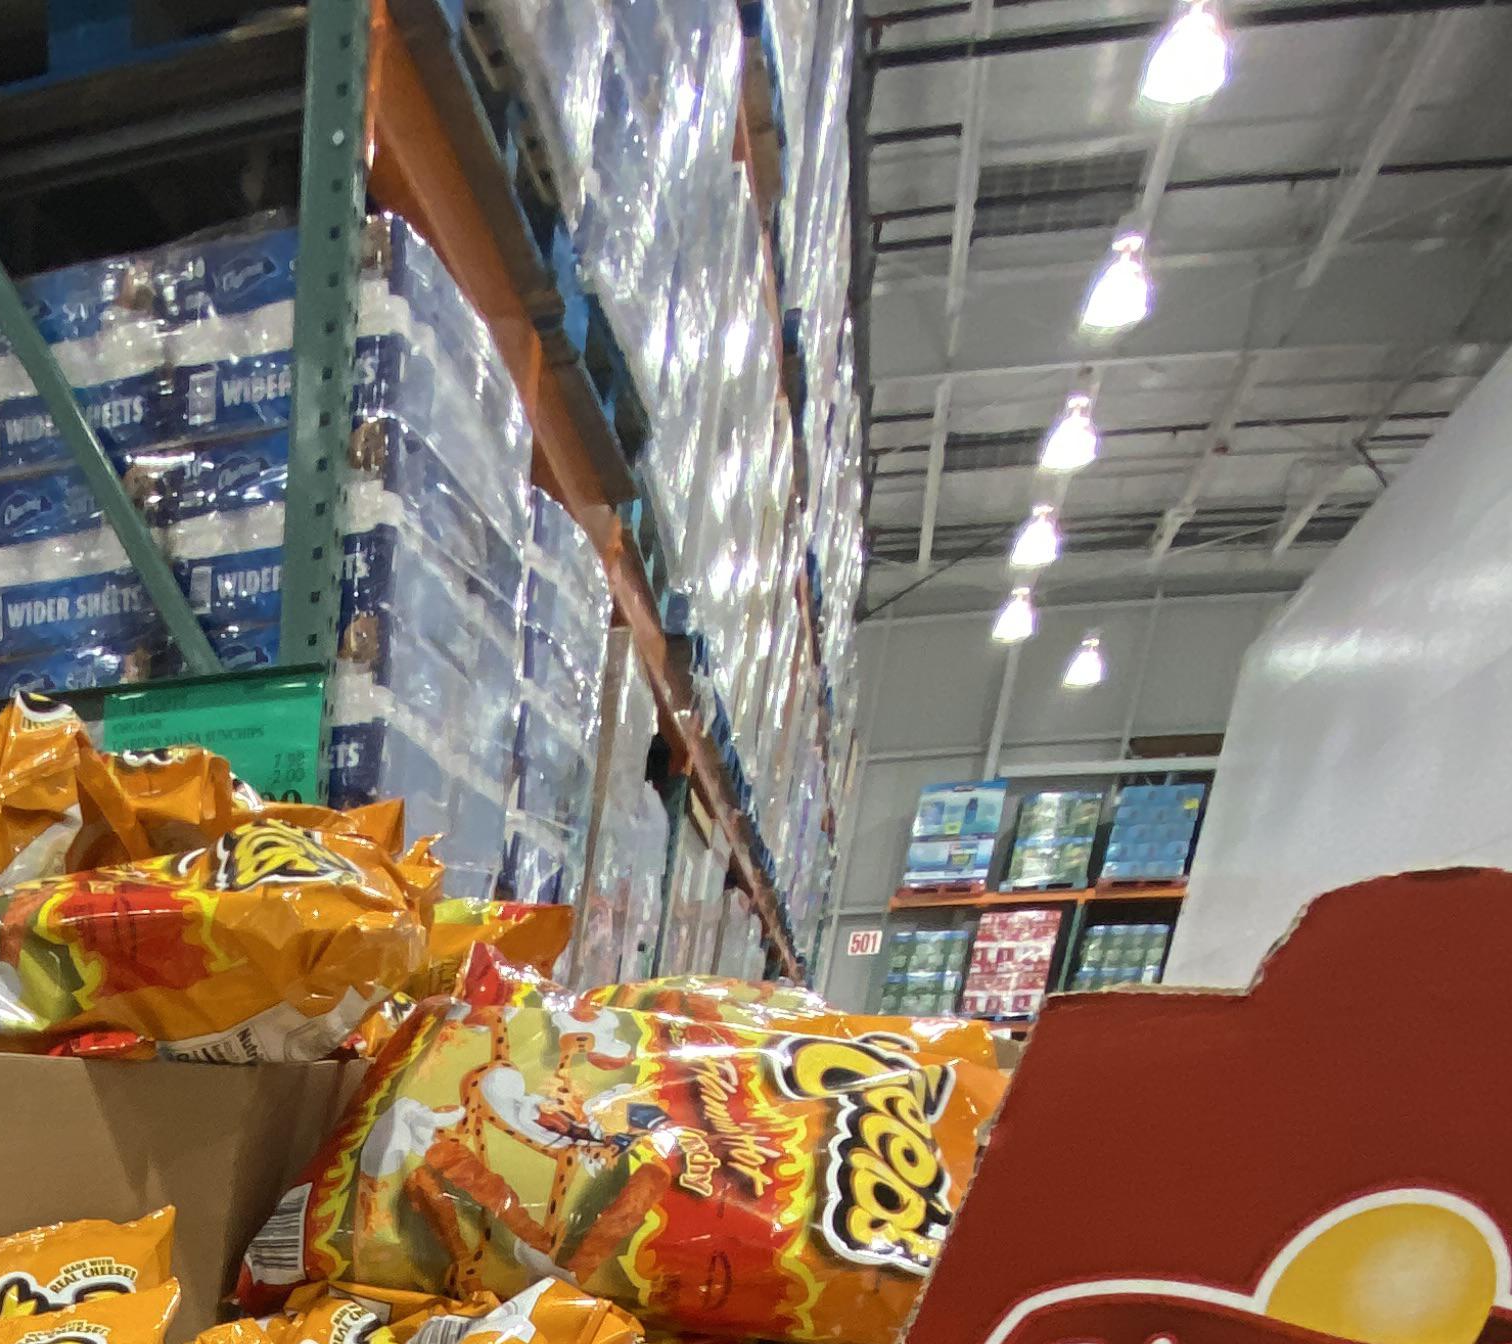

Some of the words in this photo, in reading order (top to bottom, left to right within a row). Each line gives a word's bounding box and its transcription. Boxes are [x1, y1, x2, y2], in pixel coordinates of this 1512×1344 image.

[7, 594, 69, 629] WIDER
[850, 933, 879, 953] 501
[48, 1273, 81, 1294] REAL
[82, 1265, 138, 1281] CHEESE!
